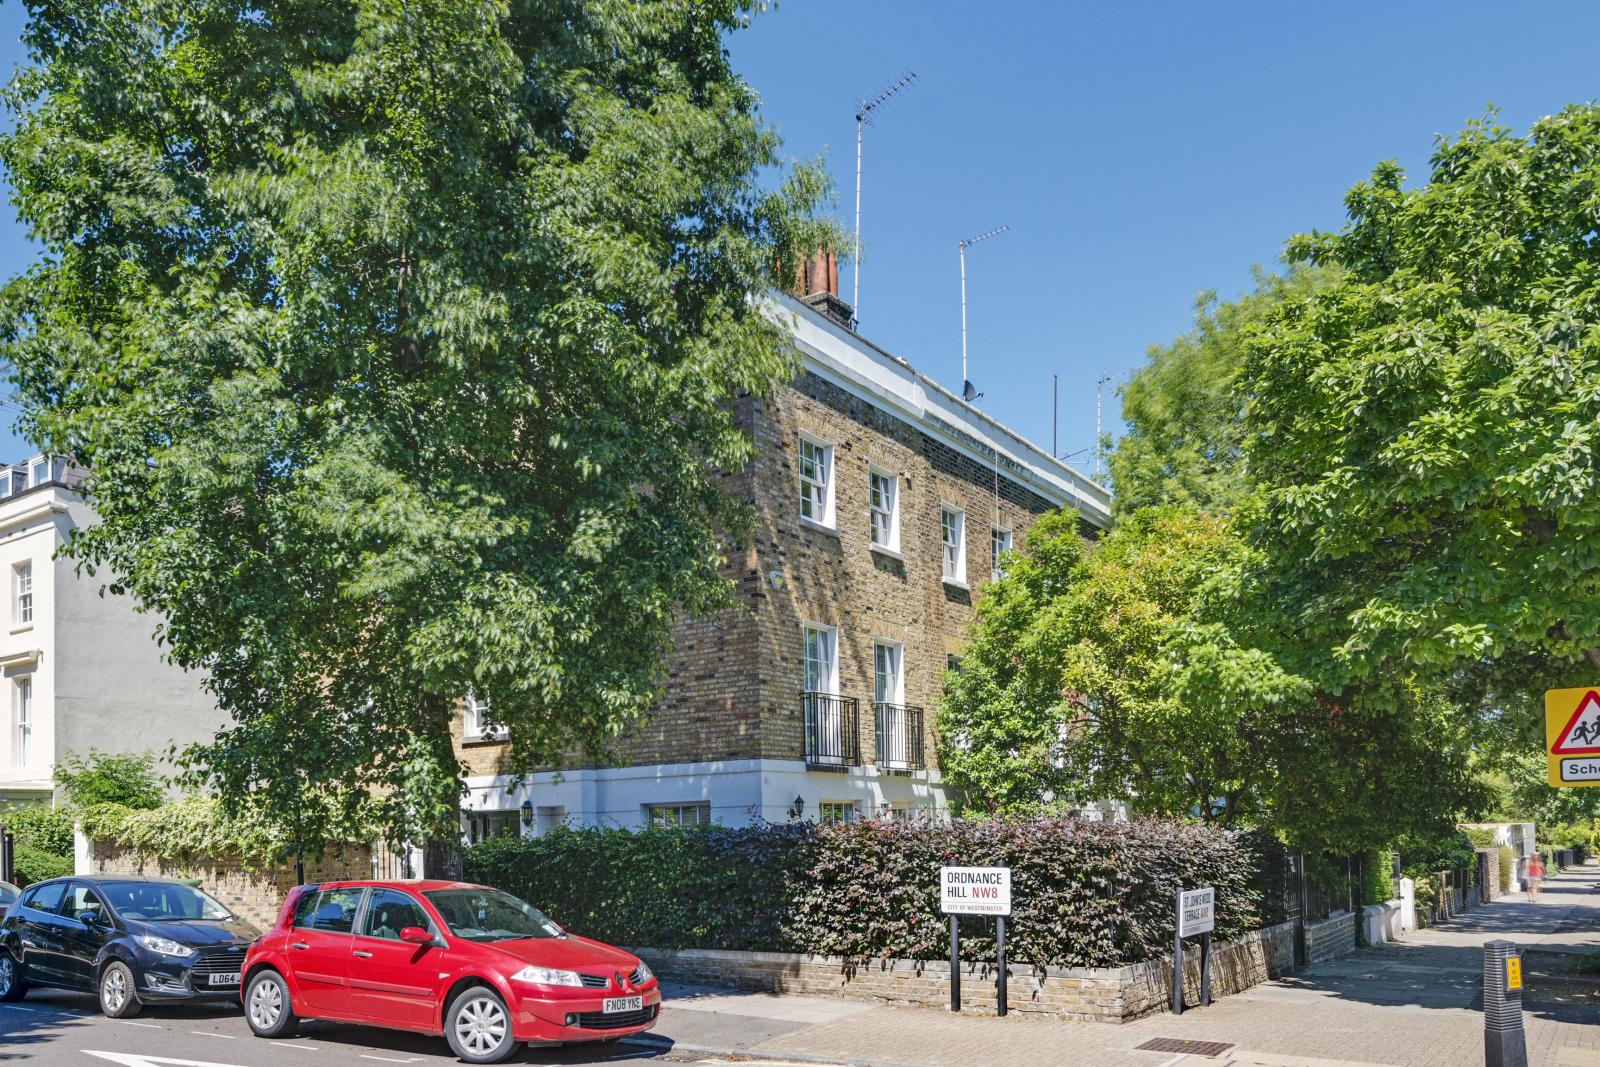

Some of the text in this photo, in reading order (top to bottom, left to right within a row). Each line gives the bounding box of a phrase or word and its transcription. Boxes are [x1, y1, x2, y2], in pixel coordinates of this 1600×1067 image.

[1569, 763, 1600, 775] Sch
[947, 872, 1003, 885] ORDNANCE
[947, 886, 998, 899] HILL NW8
[212, 974, 235, 984] LD64
[606, 999, 626, 1011] FN08
